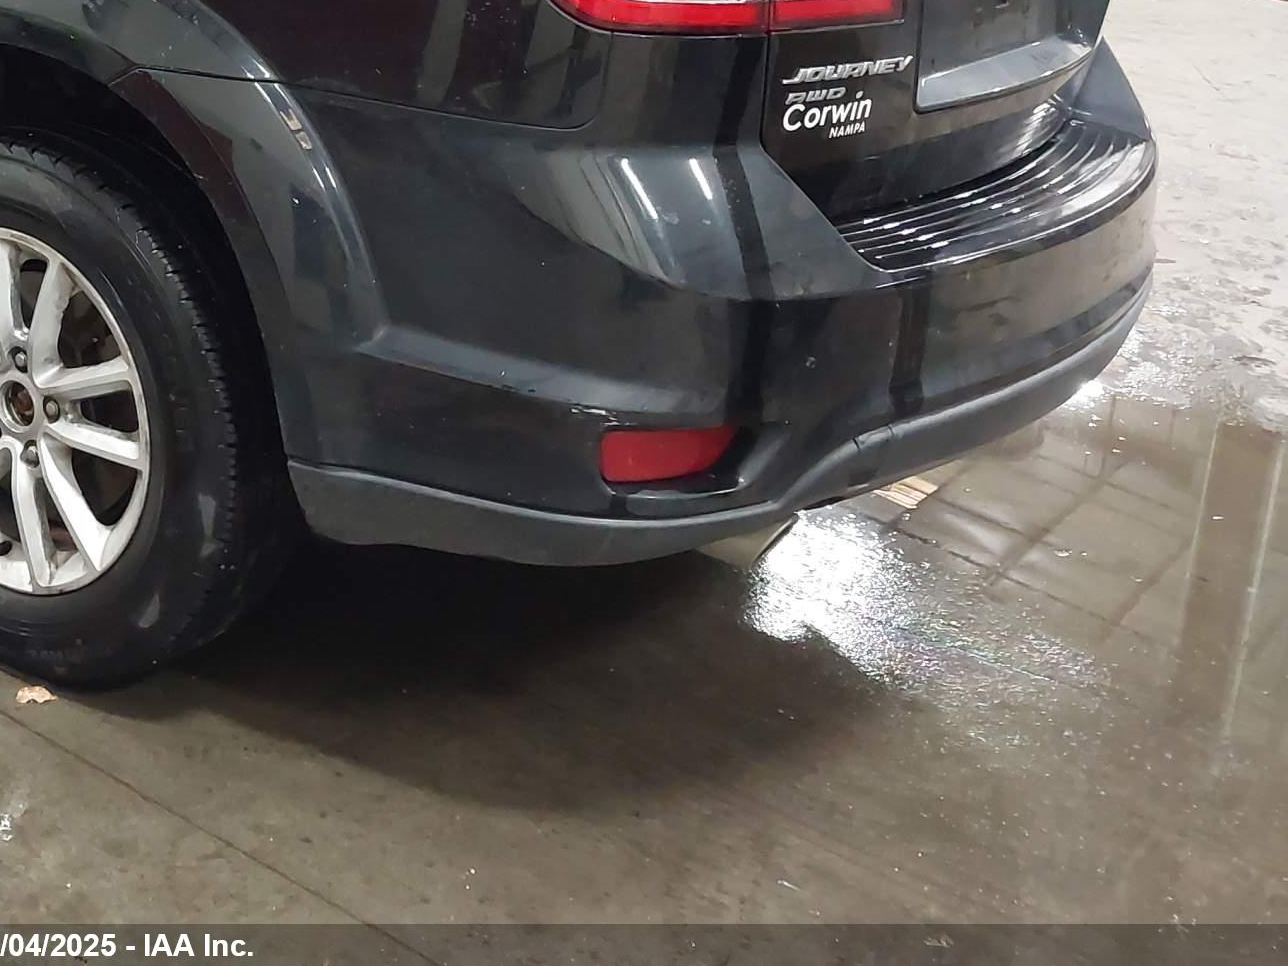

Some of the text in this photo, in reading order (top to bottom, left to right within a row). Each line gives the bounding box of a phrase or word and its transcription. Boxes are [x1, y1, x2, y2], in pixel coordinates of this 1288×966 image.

[781, 55, 914, 85] JOURNEY
[782, 90, 872, 131] Corwin
[828, 120, 866, 139] NAMPA
